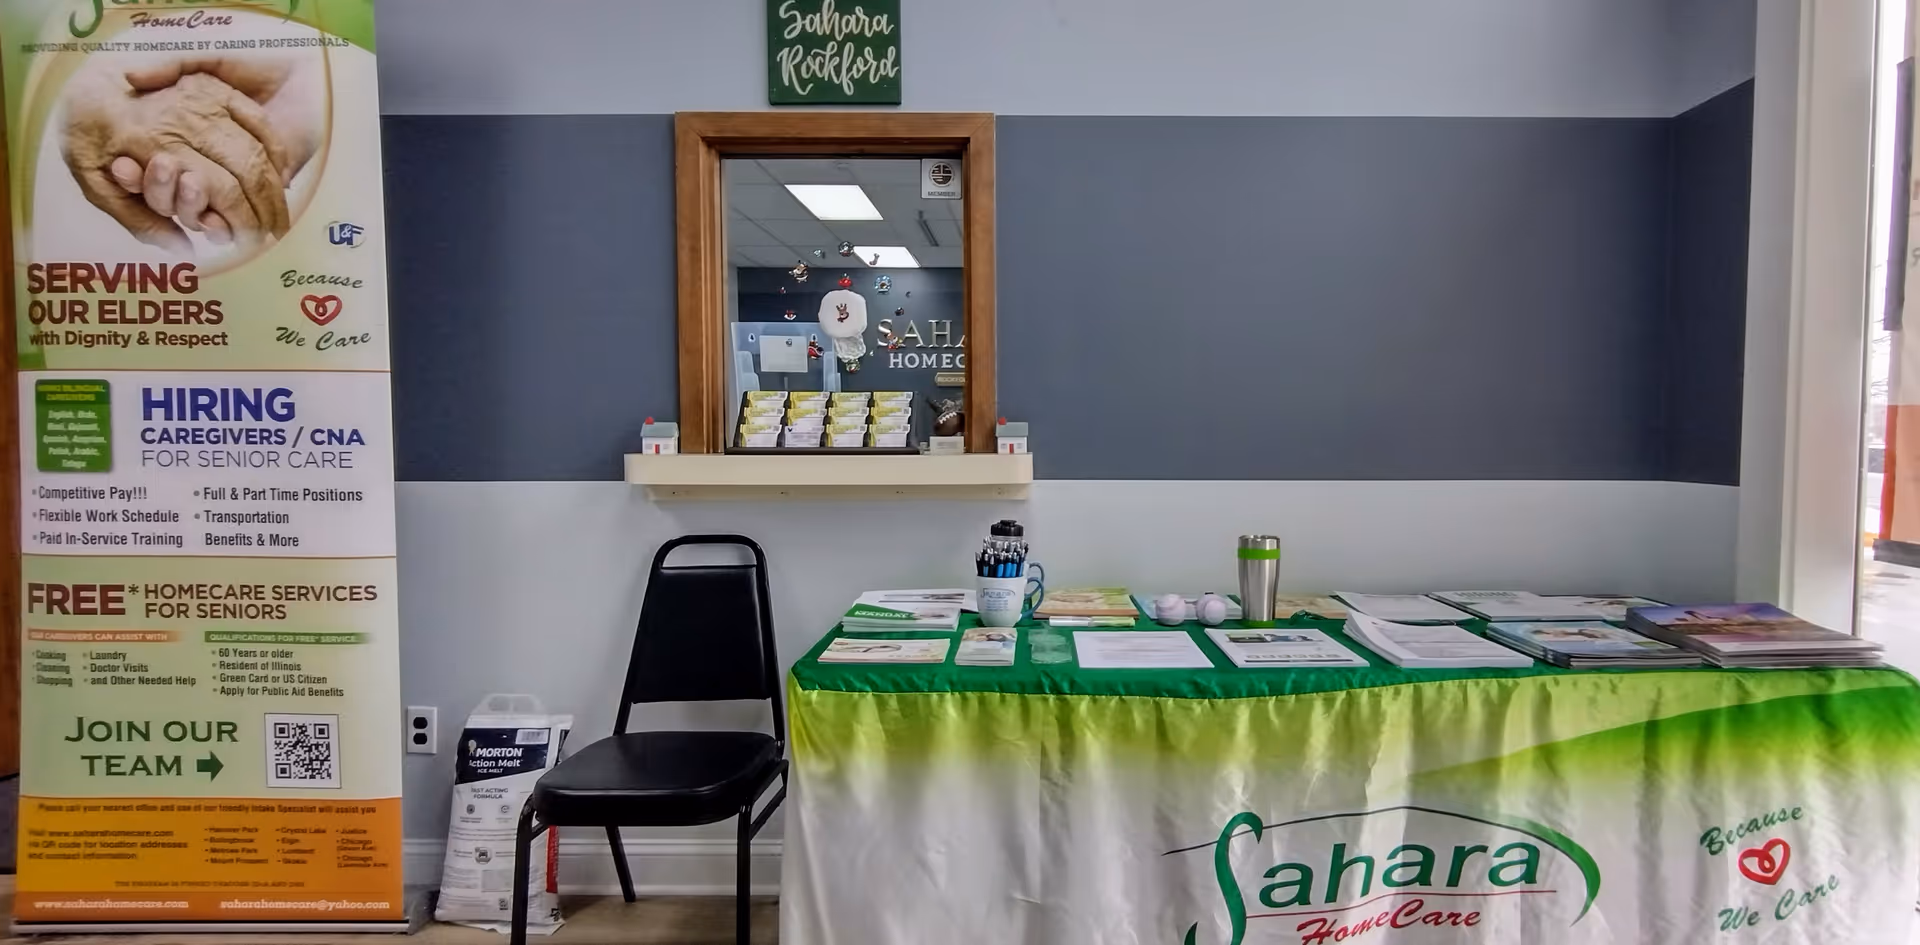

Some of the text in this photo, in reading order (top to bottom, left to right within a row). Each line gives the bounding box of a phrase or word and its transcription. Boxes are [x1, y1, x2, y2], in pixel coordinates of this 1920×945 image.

[130, 10, 233, 29] HomeCare
[779, 0, 894, 41] Sahara
[81, 42, 130, 54] QUALITY
[134, 41, 194, 51] HOMECARE
[197, 41, 211, 50] BY
[214, 39, 256, 50] CARING
[259, 37, 350, 48] PROFESSIONALS
[777, 41, 900, 96] Rockford
[27, 261, 200, 294] SERVING
[280, 269, 363, 290] Because
[28, 299, 225, 325] OUR ELDERS
[29, 331, 229, 349] with Dignity & Respect
[275, 326, 372, 352] We Care
[141, 387, 296, 423] HIRING
[140, 426, 366, 449] CAREGIVERS / CNA
[141, 449, 354, 470] FOR SENIOR CARE
[38, 486, 148, 502] Competitive Pay!!!
[203, 487, 363, 502] Full & Part Time Positions
[39, 509, 180, 523] Flexible Work Schedule
[203, 510, 290, 527] Transportation
[39, 532, 183, 549] Paid In-Service Training
[205, 533, 300, 548] Benefits & More
[144, 584, 266, 602] HOMECARE
[271, 584, 378, 602] SERVICES
[144, 603, 287, 620] FOR SENIORS
[94, 632, 113, 641] CAN
[114, 633, 143, 641] ASSIST
[145, 633, 168, 641] WITH
[209, 633, 277, 642] QUALIFICATIONS
[277, 634, 294, 642] FOR
[89, 651, 127, 662] Laundry
[218, 648, 294, 658] 60 Years or older
[90, 663, 149, 672] Doctor Visits
[219, 661, 302, 671] Resident of Illinois
[90, 676, 197, 687] and Other Needed Help
[219, 673, 328, 684] Green Card or US Citizen
[219, 686, 344, 697] Apply for Public Aid Benefits
[64, 716, 239, 743] JOIN OUR
[476, 747, 524, 758] MORTON
[80, 754, 183, 777] TEAM
[1700, 806, 1805, 856] Because
[1183, 812, 1543, 945] Sahara
[1717, 874, 1840, 932] We Care
[1296, 898, 1482, 945] HomeCare
